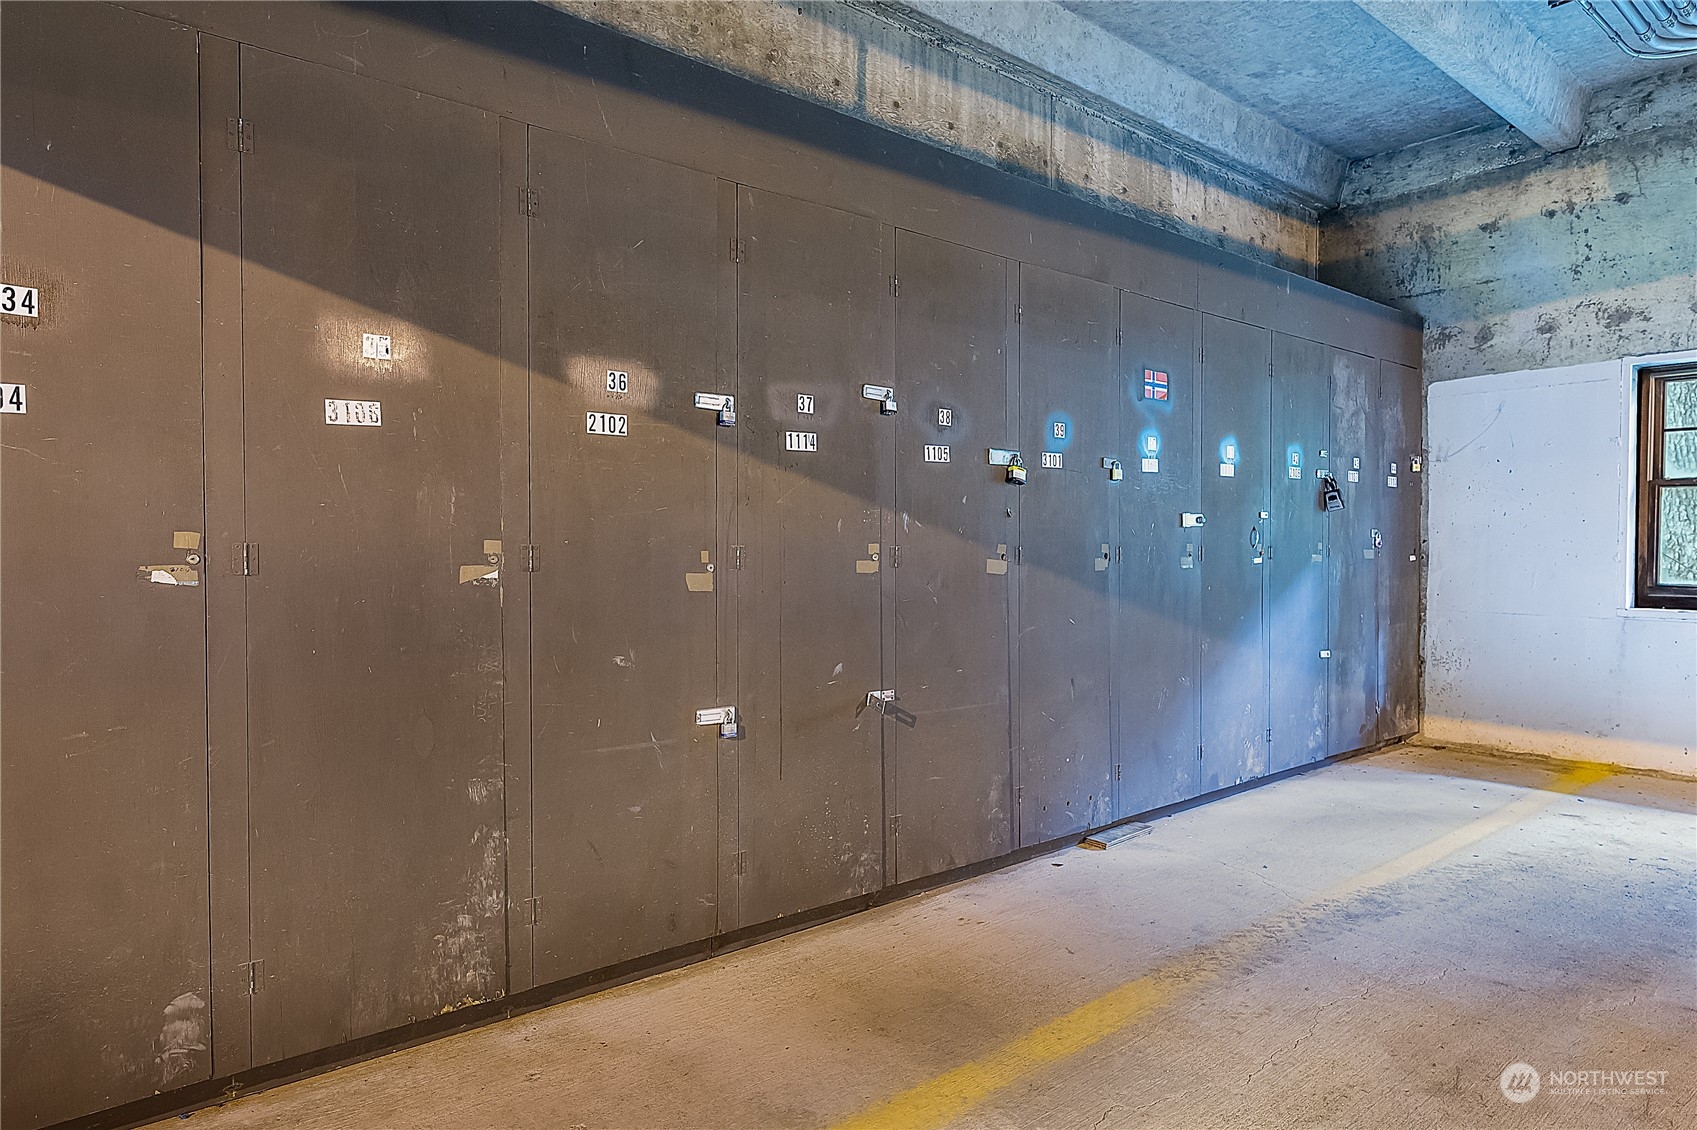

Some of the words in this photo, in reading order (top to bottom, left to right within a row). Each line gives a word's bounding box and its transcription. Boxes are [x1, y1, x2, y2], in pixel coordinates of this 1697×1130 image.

[608, 372, 627, 391] 36
[0, 386, 24, 411] 4
[799, 396, 813, 412] 37
[588, 413, 626, 434] 2102
[939, 410, 951, 425] 38
[1054, 423, 1065, 437] 39
[788, 432, 816, 450] 1114
[926, 446, 949, 462] 1105
[1042, 453, 1062, 468] 3101
